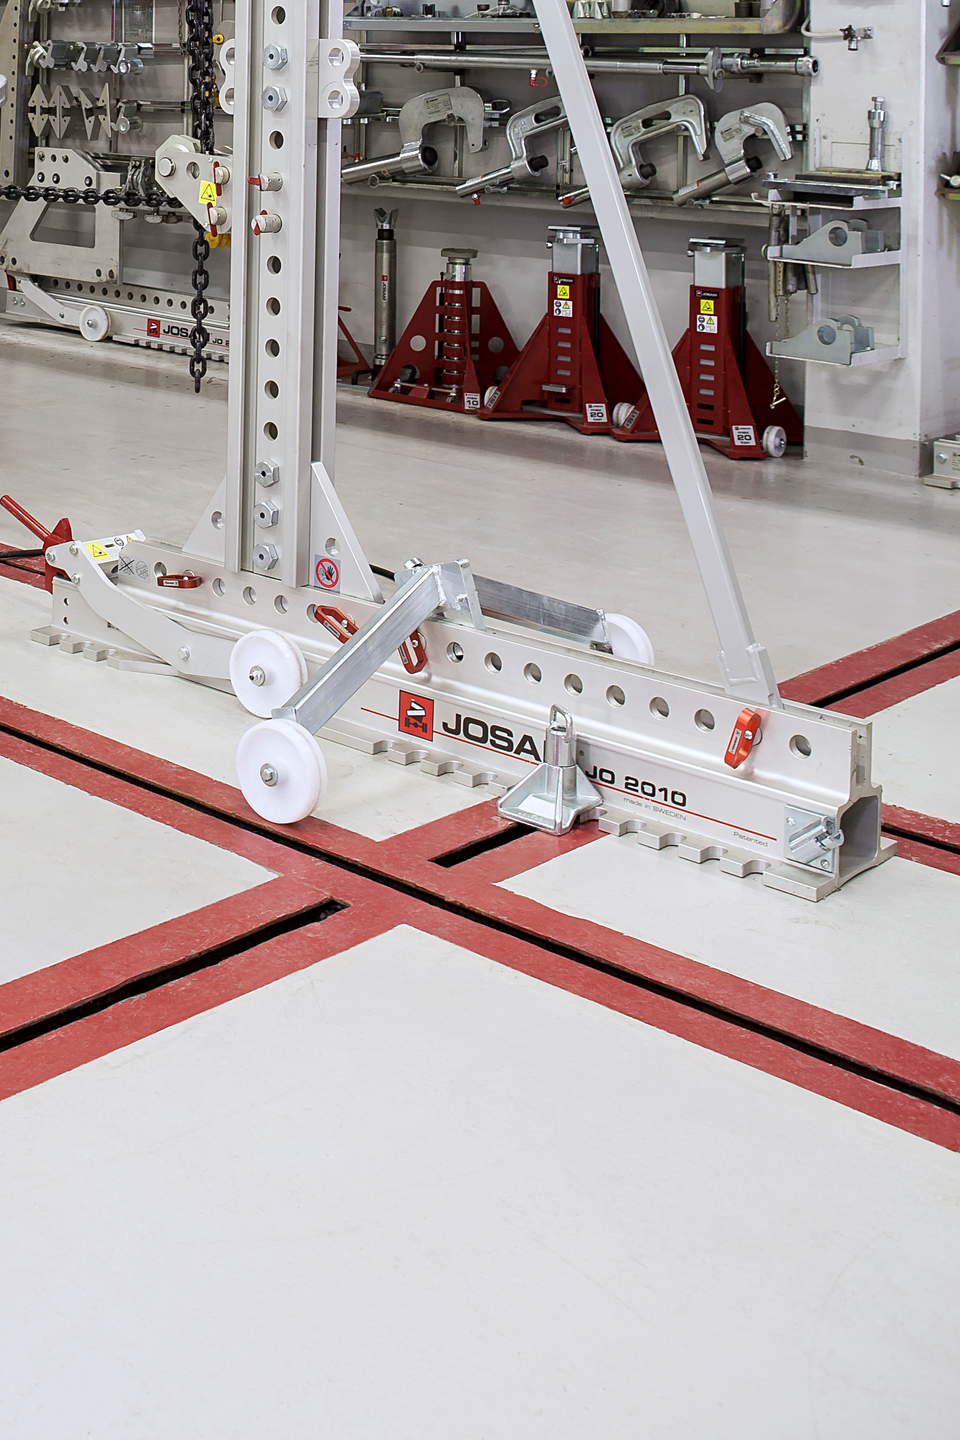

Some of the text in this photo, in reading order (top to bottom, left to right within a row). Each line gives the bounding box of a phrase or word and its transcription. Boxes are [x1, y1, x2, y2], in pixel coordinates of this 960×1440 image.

[624, 776, 687, 808] 2010
[623, 797, 642, 807] made
[652, 806, 687, 822] SWEDEN
[733, 831, 768, 848] Patented
